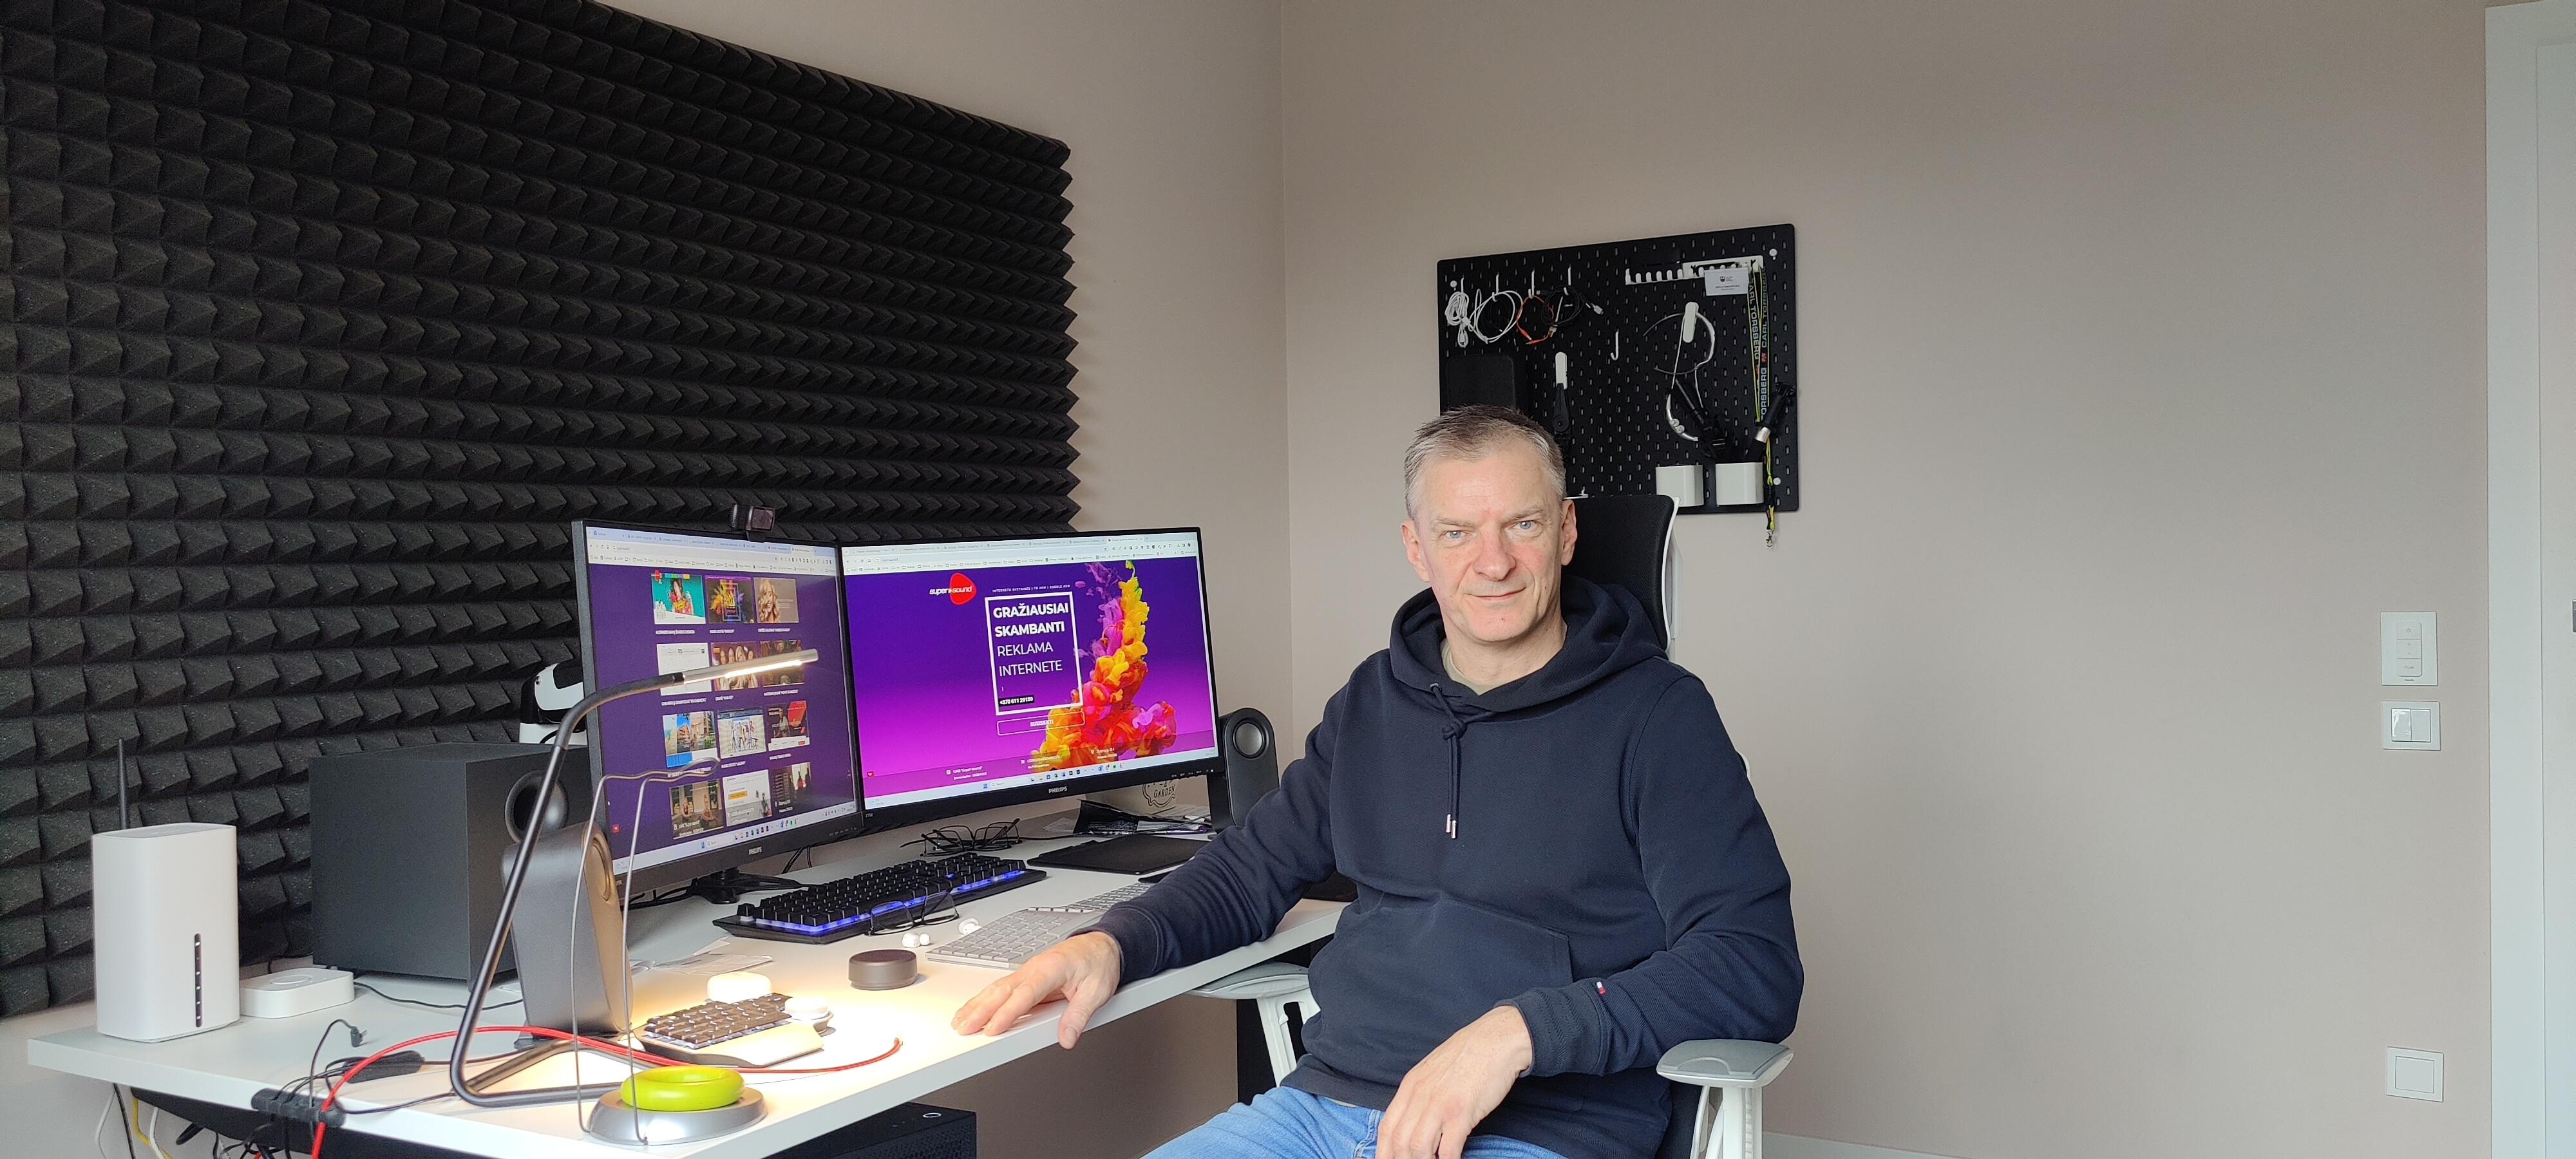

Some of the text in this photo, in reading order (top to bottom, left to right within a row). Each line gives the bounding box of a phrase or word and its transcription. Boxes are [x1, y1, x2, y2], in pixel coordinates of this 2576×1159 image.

[1750, 305, 1760, 360] TORSBERG
[993, 603, 1069, 619] GRAŽIAUSIAI
[994, 621, 1065, 637] SKAMBANTI
[997, 641, 1054, 657] REKLAMA
[999, 659, 1063, 677] INTERNETE
[1153, 784, 1175, 798] GARDEN
